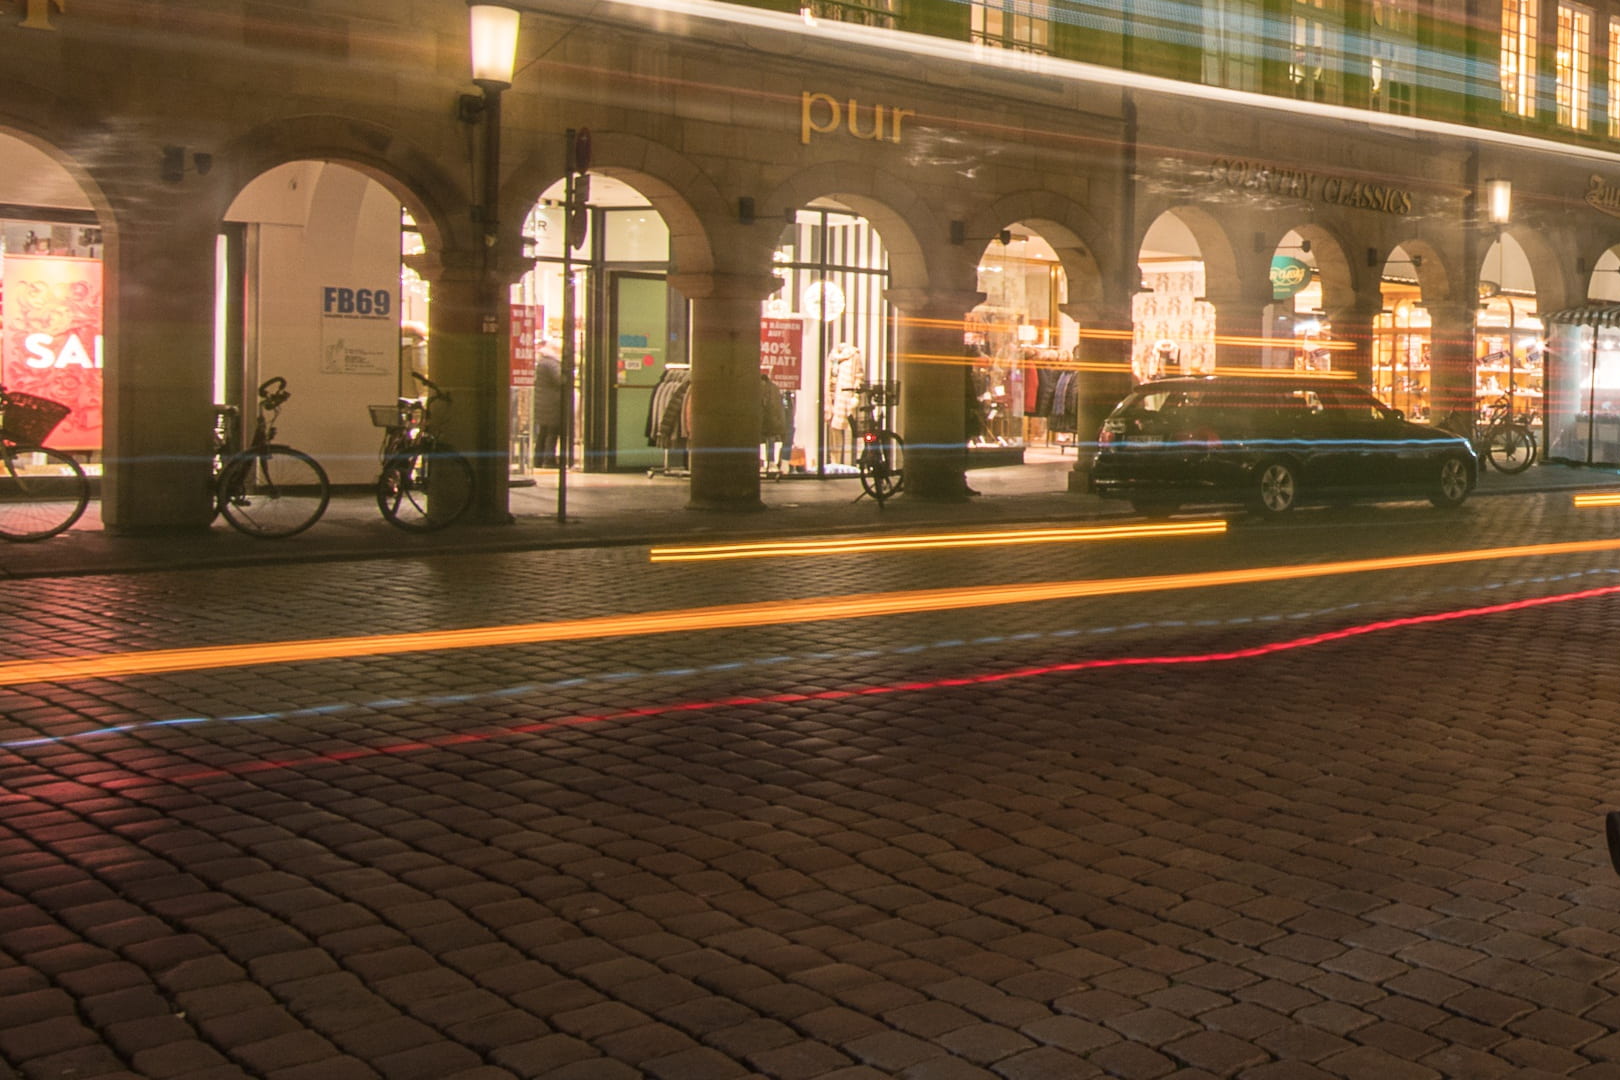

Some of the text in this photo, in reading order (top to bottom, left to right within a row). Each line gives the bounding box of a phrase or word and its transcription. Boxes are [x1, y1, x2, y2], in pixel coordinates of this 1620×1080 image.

[802, 91, 915, 144] pur
[1322, 176, 1413, 215] CLASSICS
[323, 286, 391, 316] FB69
[760, 341, 792, 354] 40%
[760, 355, 798, 367] ABATT
